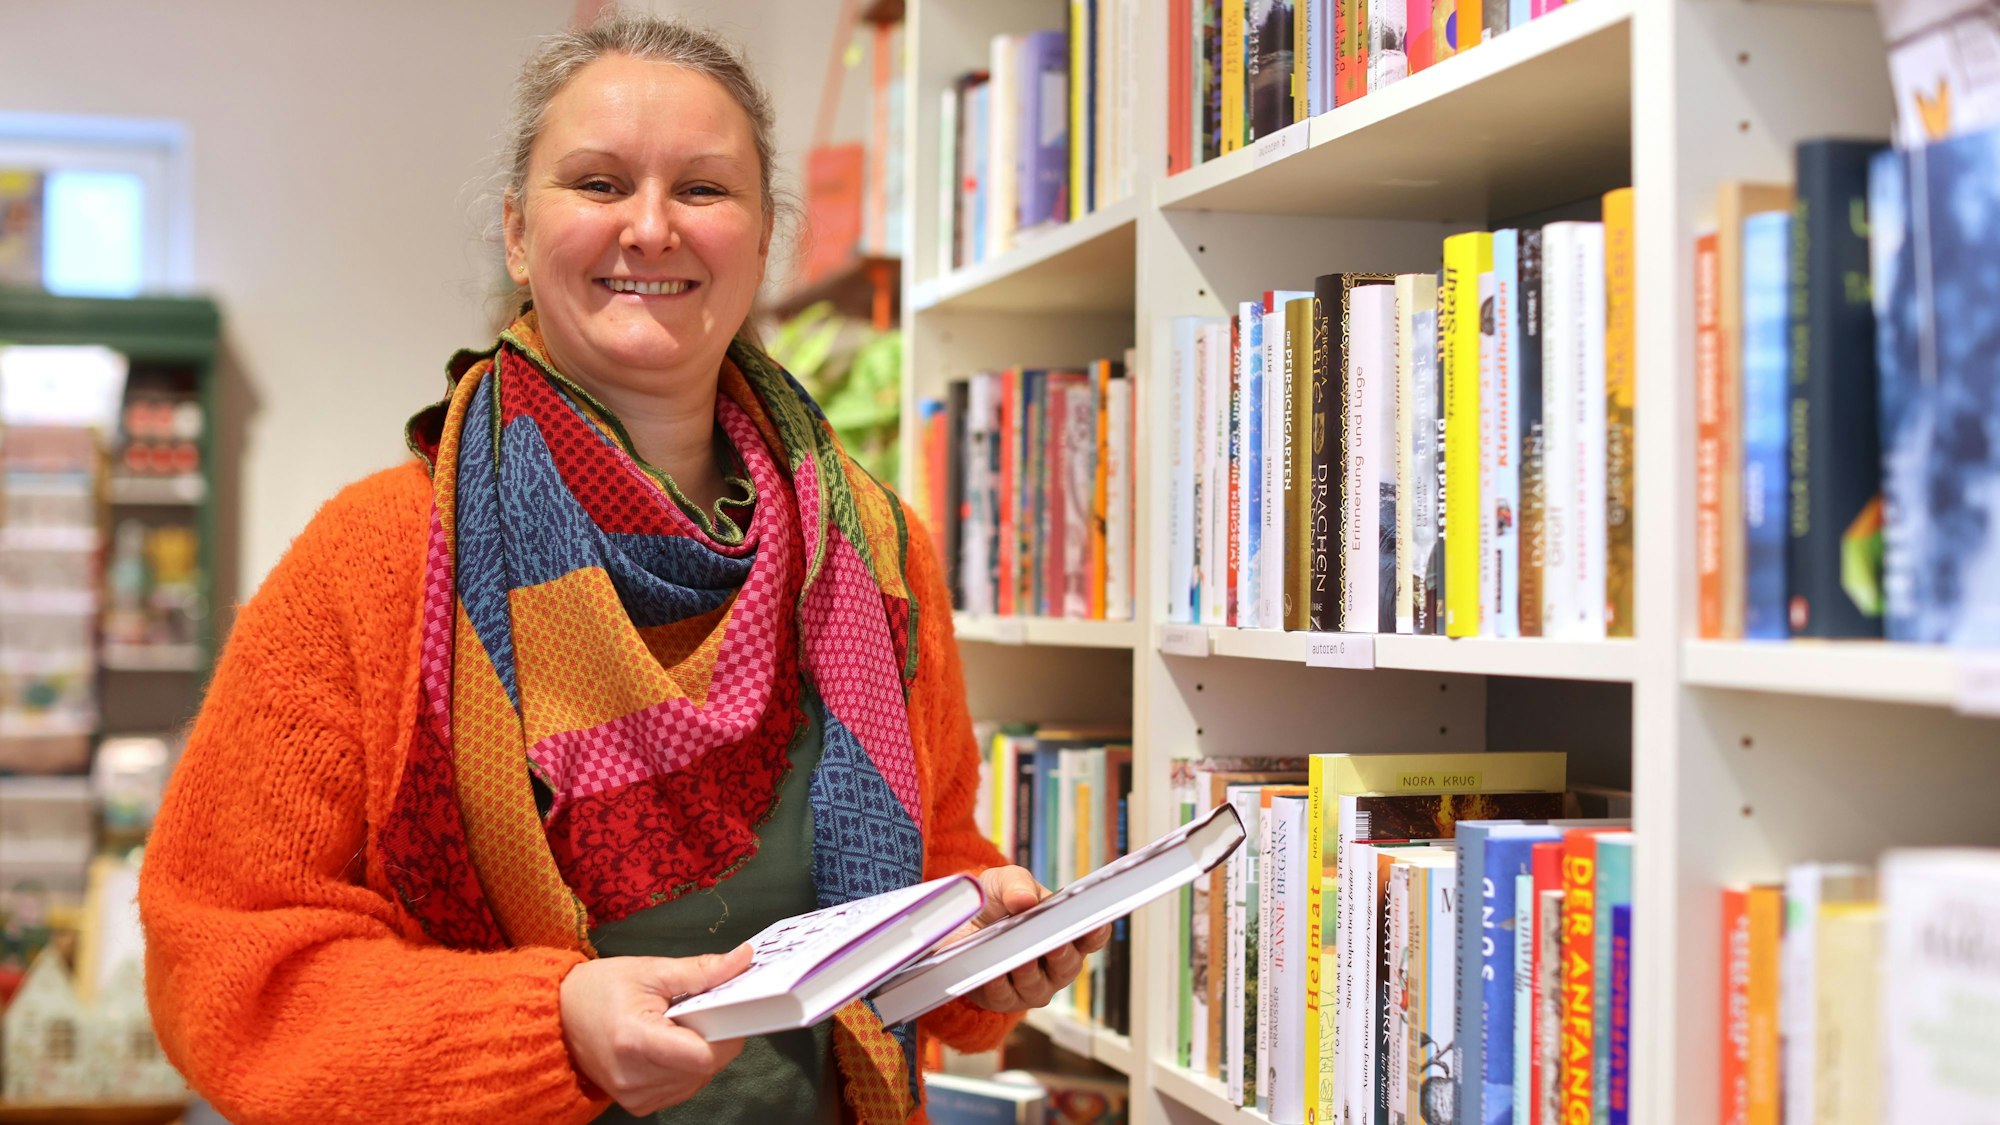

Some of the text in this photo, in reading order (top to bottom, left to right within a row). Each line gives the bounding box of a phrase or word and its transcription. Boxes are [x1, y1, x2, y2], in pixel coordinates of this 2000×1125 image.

[1437, 284, 1448, 363] DANIEL
[1446, 263, 1459, 335] Steiff
[1321, 315, 1330, 387] REBECCA
[1496, 281, 1509, 468] Kleinstadthelden
[1231, 389, 1240, 422] UND
[1284, 347, 1294, 491] PFIRSICHGARTEN
[1416, 354, 1427, 461] Rheinblick
[1230, 429, 1240, 485] HIMMEL
[1351, 365, 1366, 551] Erinnerung und Lüge
[1530, 419, 1545, 509] TALENT
[1230, 490, 1239, 571] ZWISCHEN
[1315, 463, 1329, 594] DRACHEN
[1312, 641, 1345, 655] autoren G
[1402, 775, 1476, 787] NORA KRUG
[1261, 862, 1269, 905] Ganzen
[1261, 906, 1269, 928] und
[1274, 818, 1288, 973] JEANNE BEGANN
[1306, 883, 1320, 1013] Heimat
[1346, 903, 1355, 969] Kupferberg
[1383, 880, 1392, 1046] SARAH LARK
[1260, 993, 1268, 1027] Leben
[1261, 976, 1268, 991] im
[1345, 973, 1354, 1010] Shelly
[1568, 856, 1594, 1125] DER ANFANG
[1260, 1029, 1268, 1051] Das
[1362, 1053, 1370, 1092] Andrej
